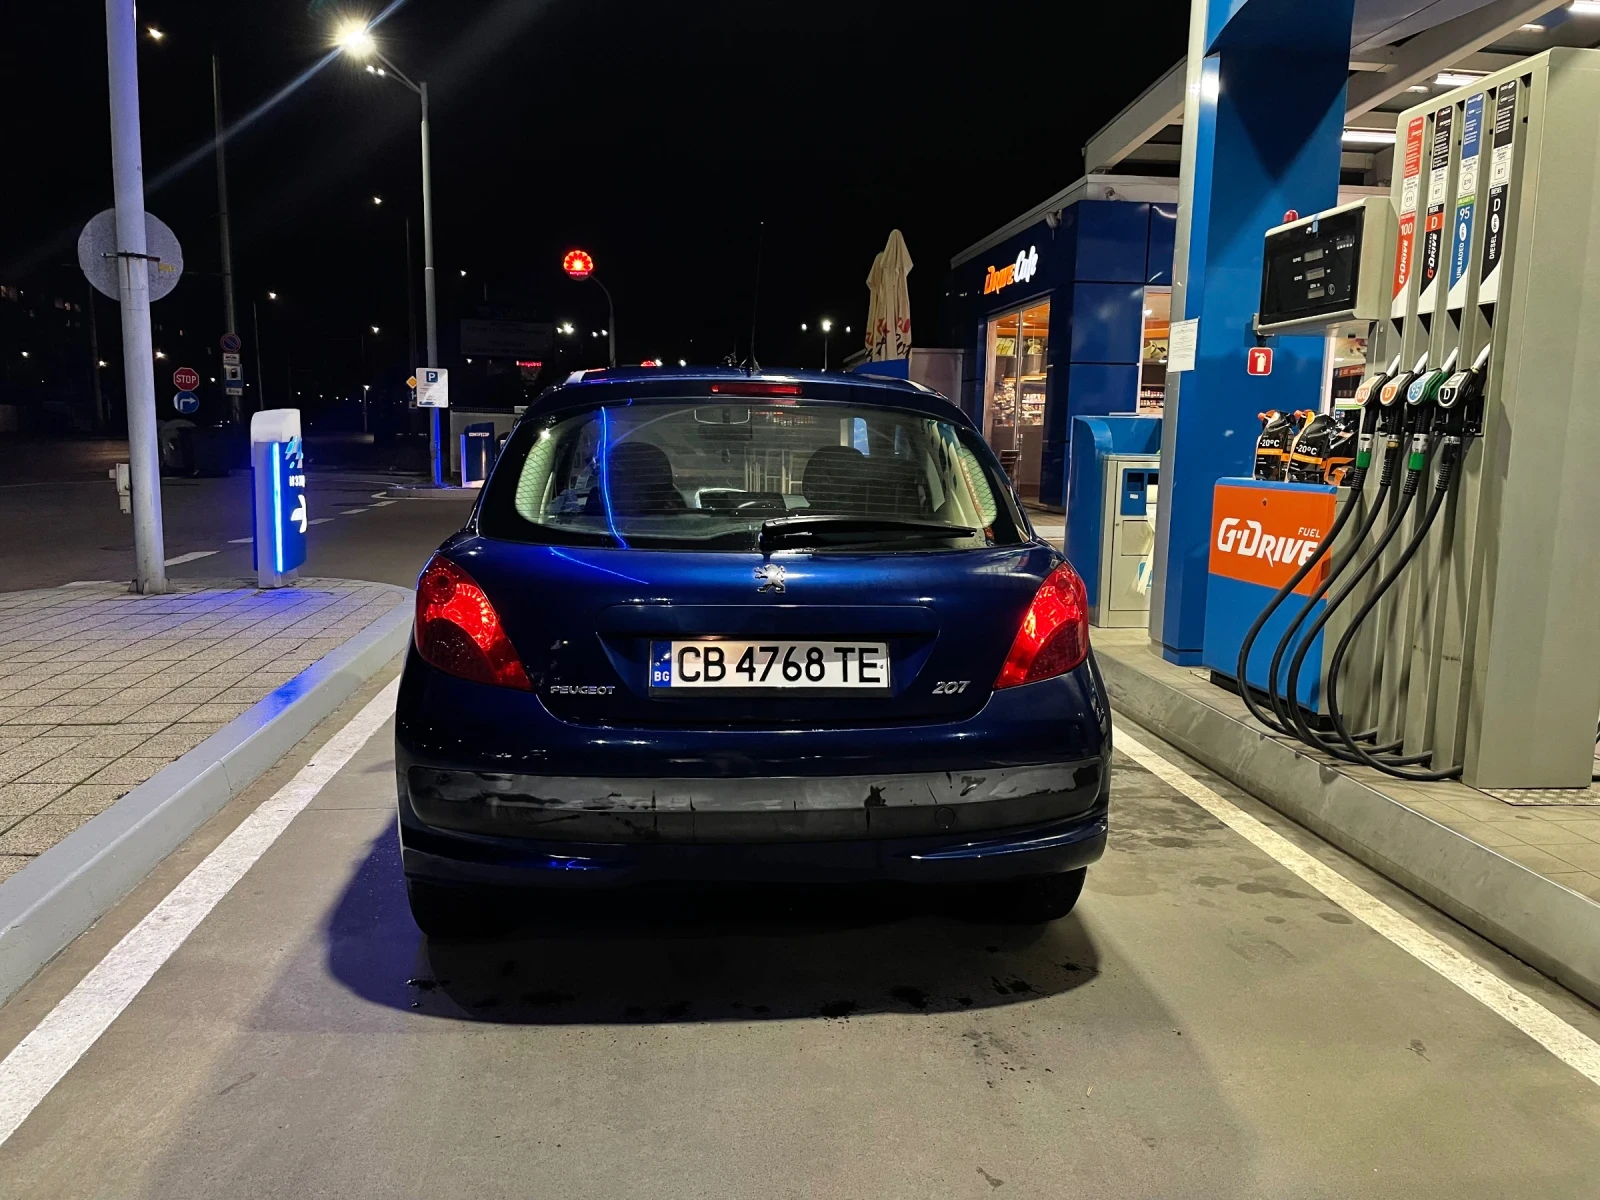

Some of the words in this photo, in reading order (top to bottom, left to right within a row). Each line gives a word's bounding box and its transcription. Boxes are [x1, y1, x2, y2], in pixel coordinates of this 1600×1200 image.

[1493, 198, 1501, 212] D
[1459, 206, 1471, 221] 95
[1400, 222, 1413, 236] 100
[1431, 216, 1438, 229] D
[1488, 234, 1498, 260] DIESEL
[1456, 242, 1465, 279] UNLEADED
[175, 374, 197, 384] STOP
[428, 372, 436, 382] P
[1384, 387, 1392, 398] D
[1410, 385, 1421, 397] 95
[1443, 388, 1451, 400] D
[1298, 526, 1321, 539] FUEL
[678, 646, 727, 682] CB
[735, 646, 826, 682] 4768
[833, 646, 882, 682] TE
[653, 671, 670, 682] BG
[549, 684, 616, 696] PEUGEOT
[932, 680, 972, 695] 207
